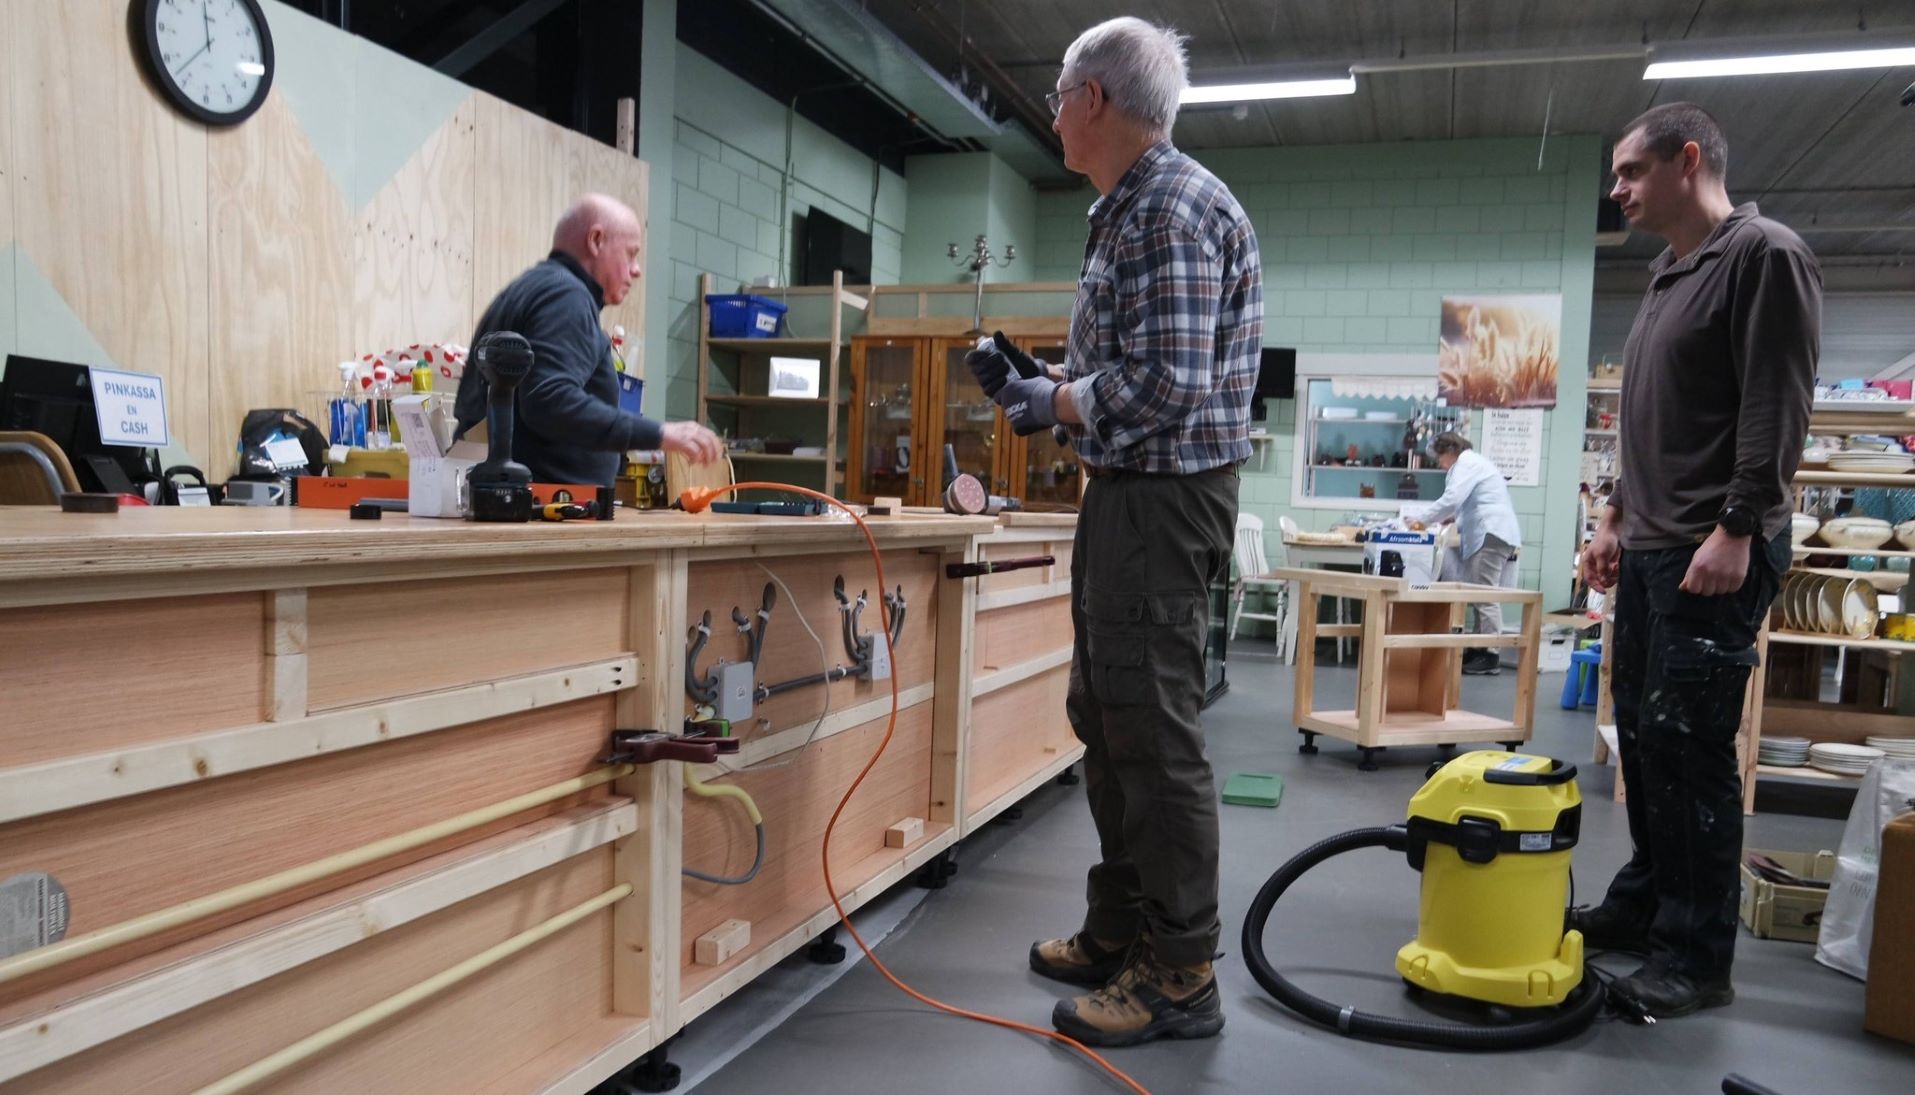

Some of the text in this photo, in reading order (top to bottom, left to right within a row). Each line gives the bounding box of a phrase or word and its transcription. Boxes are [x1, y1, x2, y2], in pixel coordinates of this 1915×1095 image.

[104, 382, 156, 399] PINKASSA
[127, 404, 137, 415] EN
[121, 420, 148, 435] CASH
